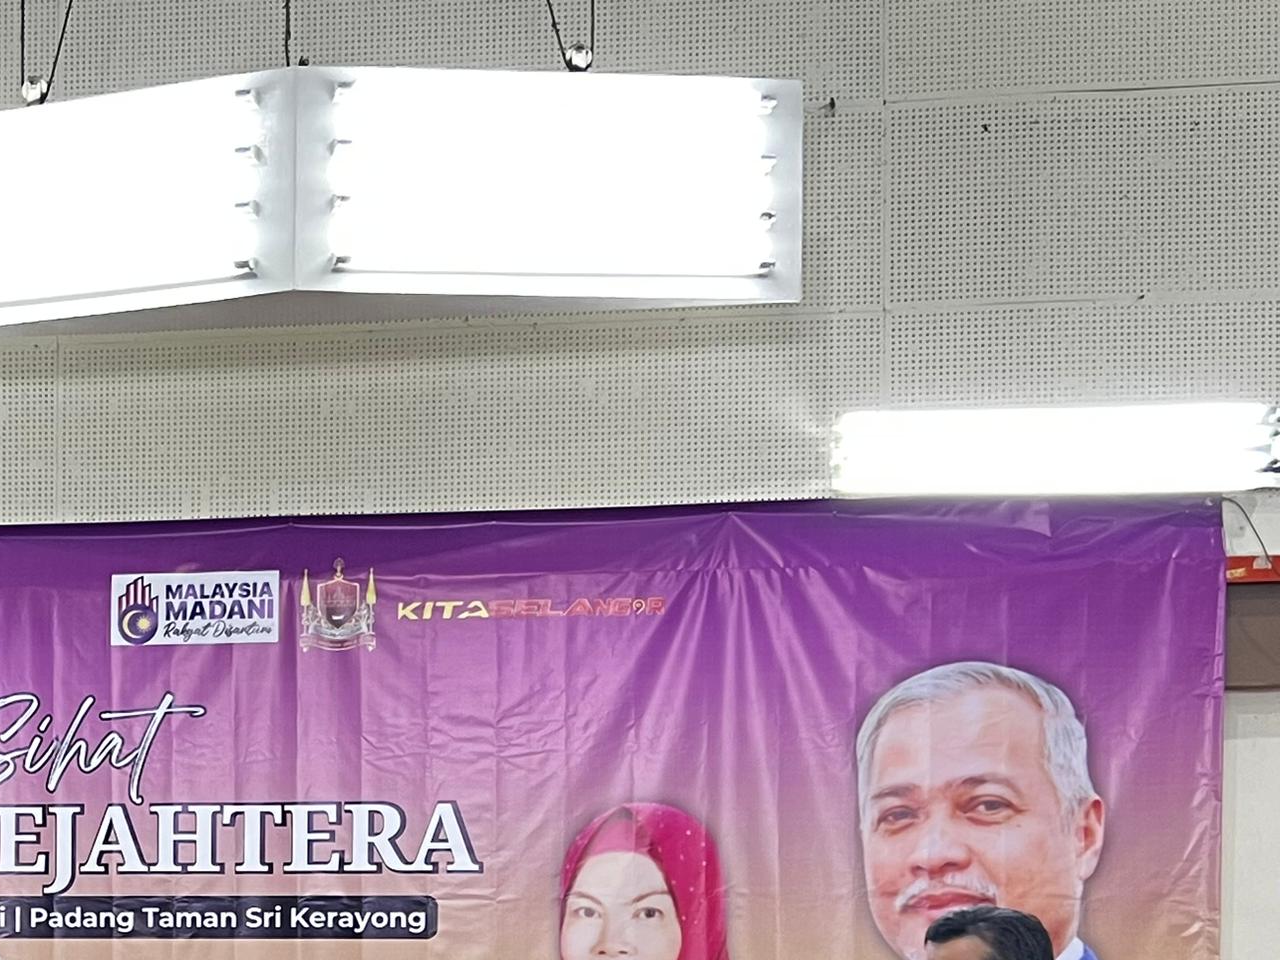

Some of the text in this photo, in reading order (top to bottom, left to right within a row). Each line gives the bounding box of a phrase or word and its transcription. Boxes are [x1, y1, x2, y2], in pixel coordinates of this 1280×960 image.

[165, 582, 274, 599] MALAYSIA
[165, 599, 274, 621] MADANI
[30, 906, 134, 933] Padang
[142, 907, 236, 928] Taman
[245, 906, 281, 928] Sri
[290, 907, 427, 934] Kerayong
